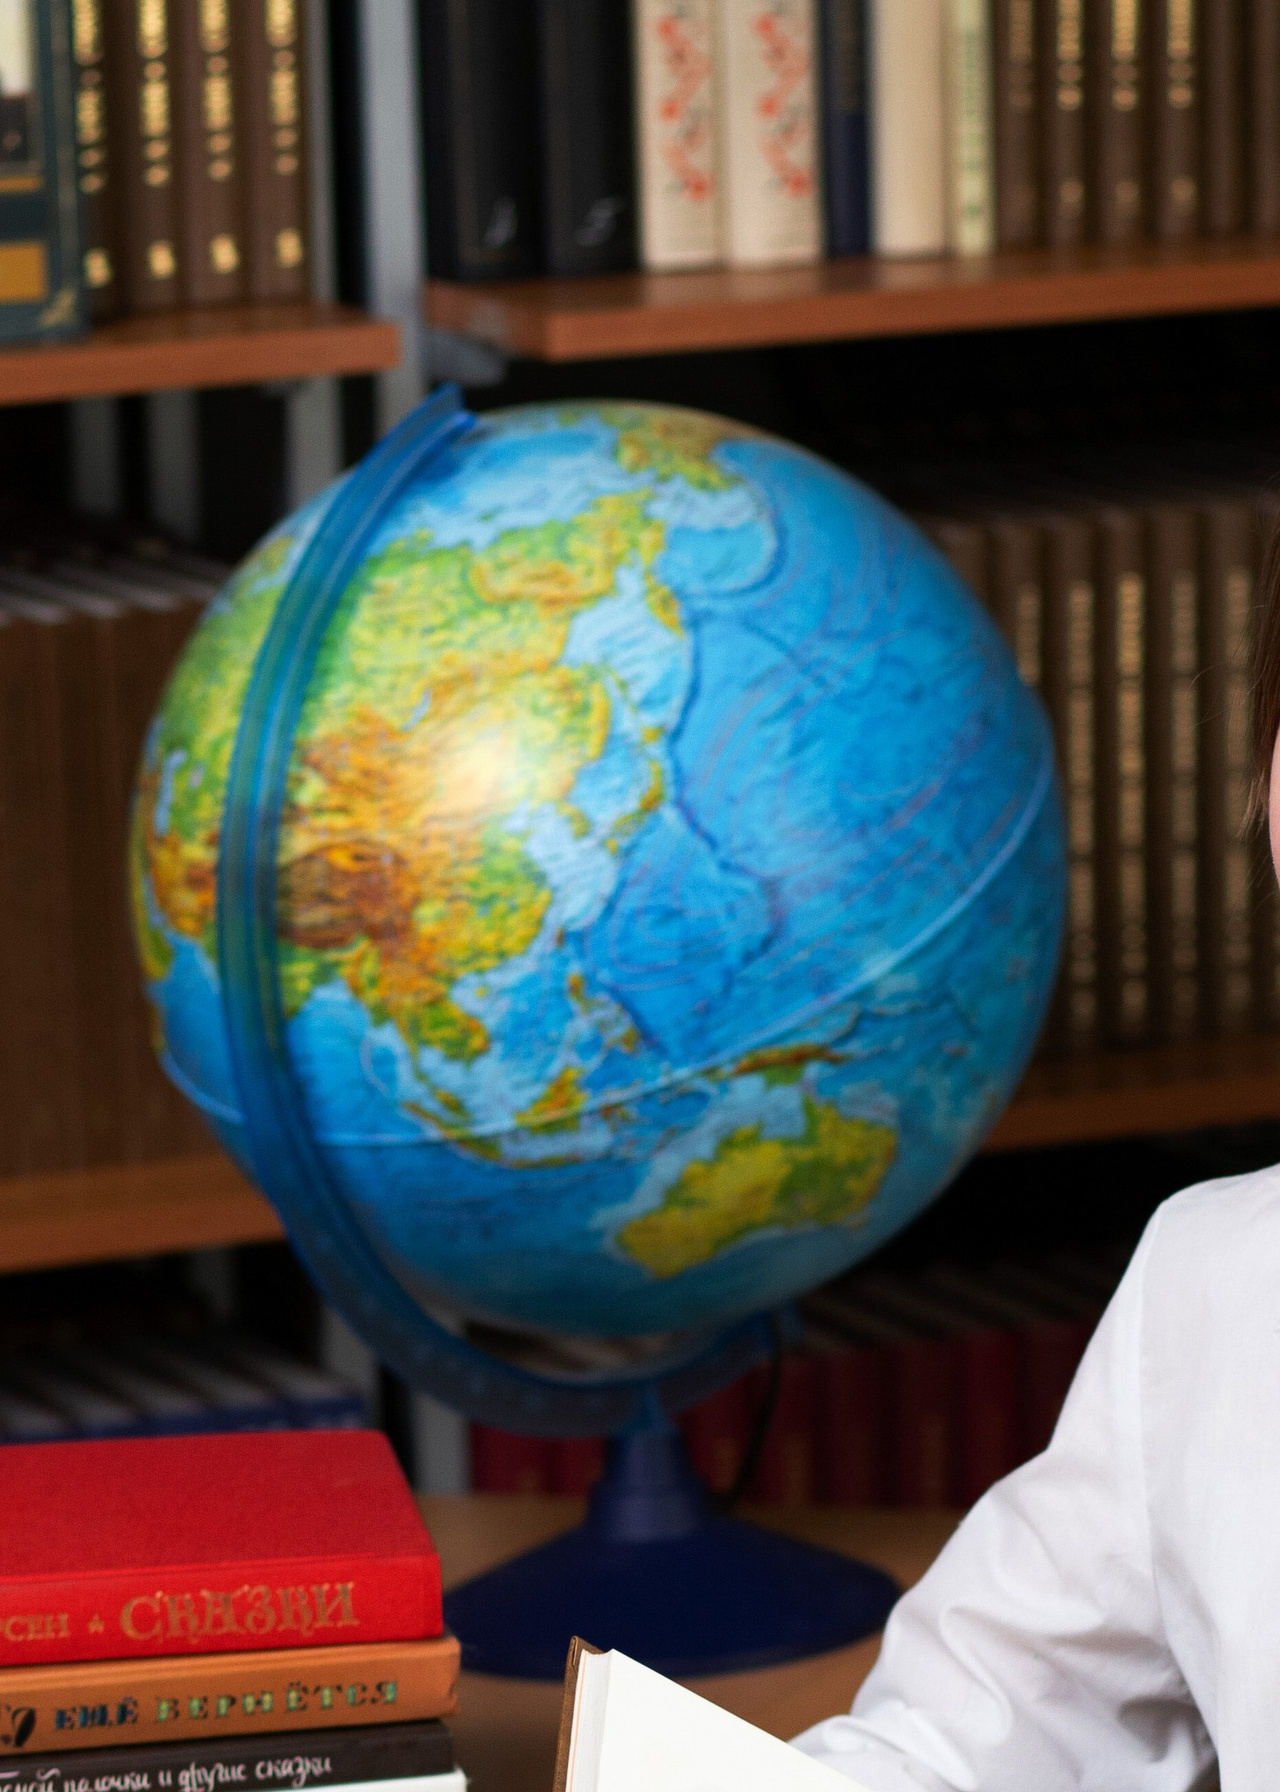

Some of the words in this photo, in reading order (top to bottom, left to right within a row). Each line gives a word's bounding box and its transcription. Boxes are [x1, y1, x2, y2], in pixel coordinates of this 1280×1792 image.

[120, 1581, 358, 1644] СКАЗКИ
[55, 1697, 138, 1730] ЕЩЁ
[155, 1680, 398, 1722] ВЕРНЁТСЯ
[158, 1770, 172, 1787] и
[255, 1756, 332, 1789] сказки
